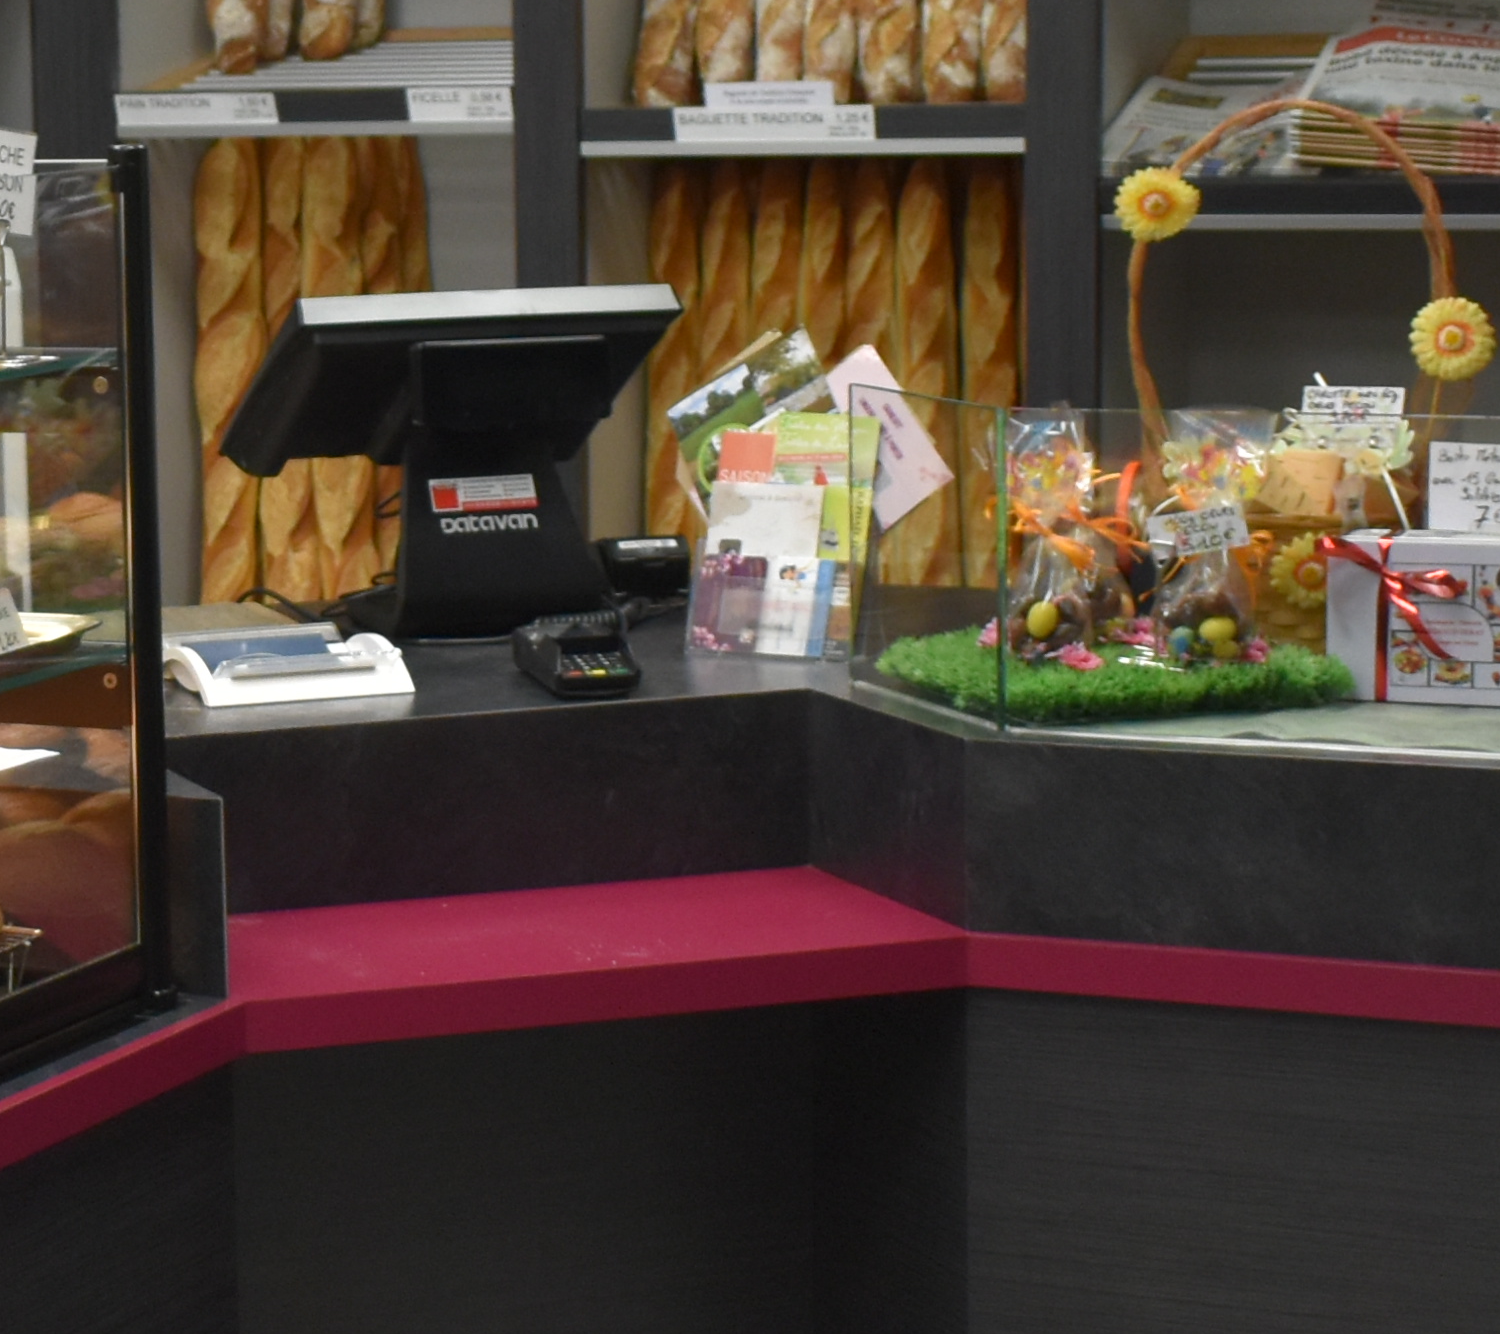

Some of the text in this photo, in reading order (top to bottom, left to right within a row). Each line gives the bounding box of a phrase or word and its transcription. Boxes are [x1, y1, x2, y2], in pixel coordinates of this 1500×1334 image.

[149, 96, 211, 108] TRADITION
[411, 91, 459, 103] FICELLE
[680, 111, 747, 125] BAGUETTE
[754, 111, 823, 124] TRADITION
